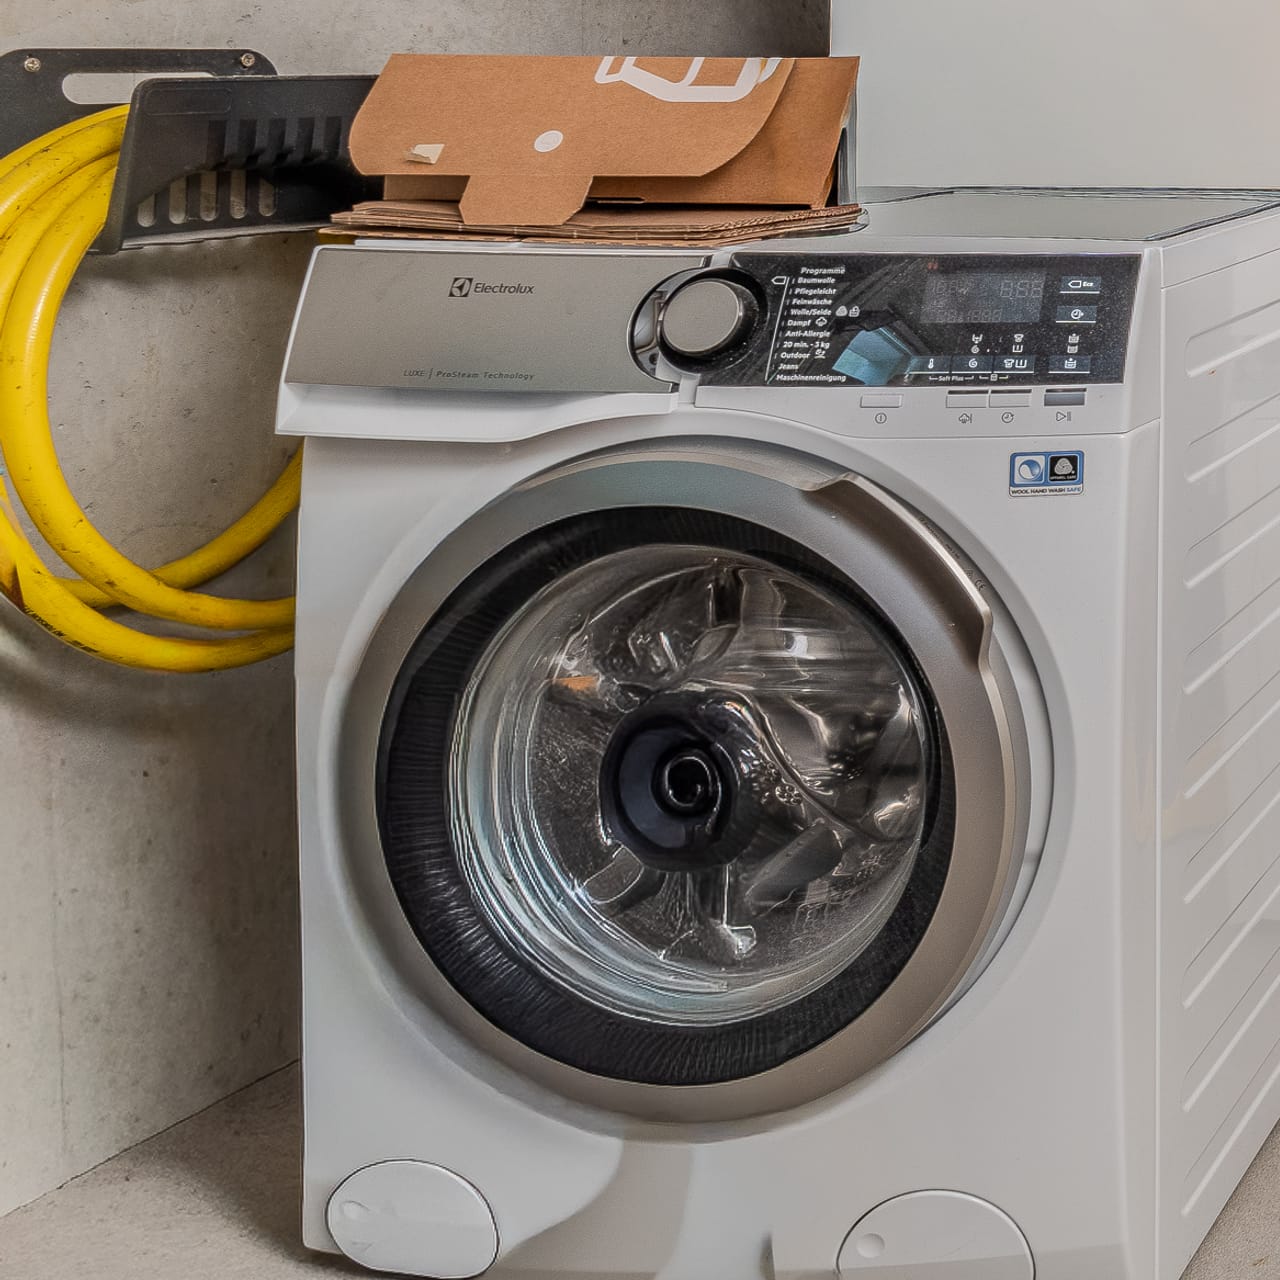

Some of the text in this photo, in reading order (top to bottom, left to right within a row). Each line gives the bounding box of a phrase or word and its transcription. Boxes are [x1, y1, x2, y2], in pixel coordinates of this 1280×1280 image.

[800, 266, 845, 275] Programme
[797, 276, 836, 284] Baumwolle
[473, 281, 535, 294] Electrolux
[794, 287, 837, 296] Pflegeleicht
[791, 298, 833, 306] Feinwäsche
[790, 308, 832, 317] Wolle/Seide
[787, 319, 812, 328] Dampf
[785, 330, 831, 338] Anti-Allergie
[780, 352, 810, 360] Outdoor
[436, 370, 480, 379] ProSteam
[484, 371, 535, 382] Technology
[776, 373, 847, 383] Maschinenreinigung
